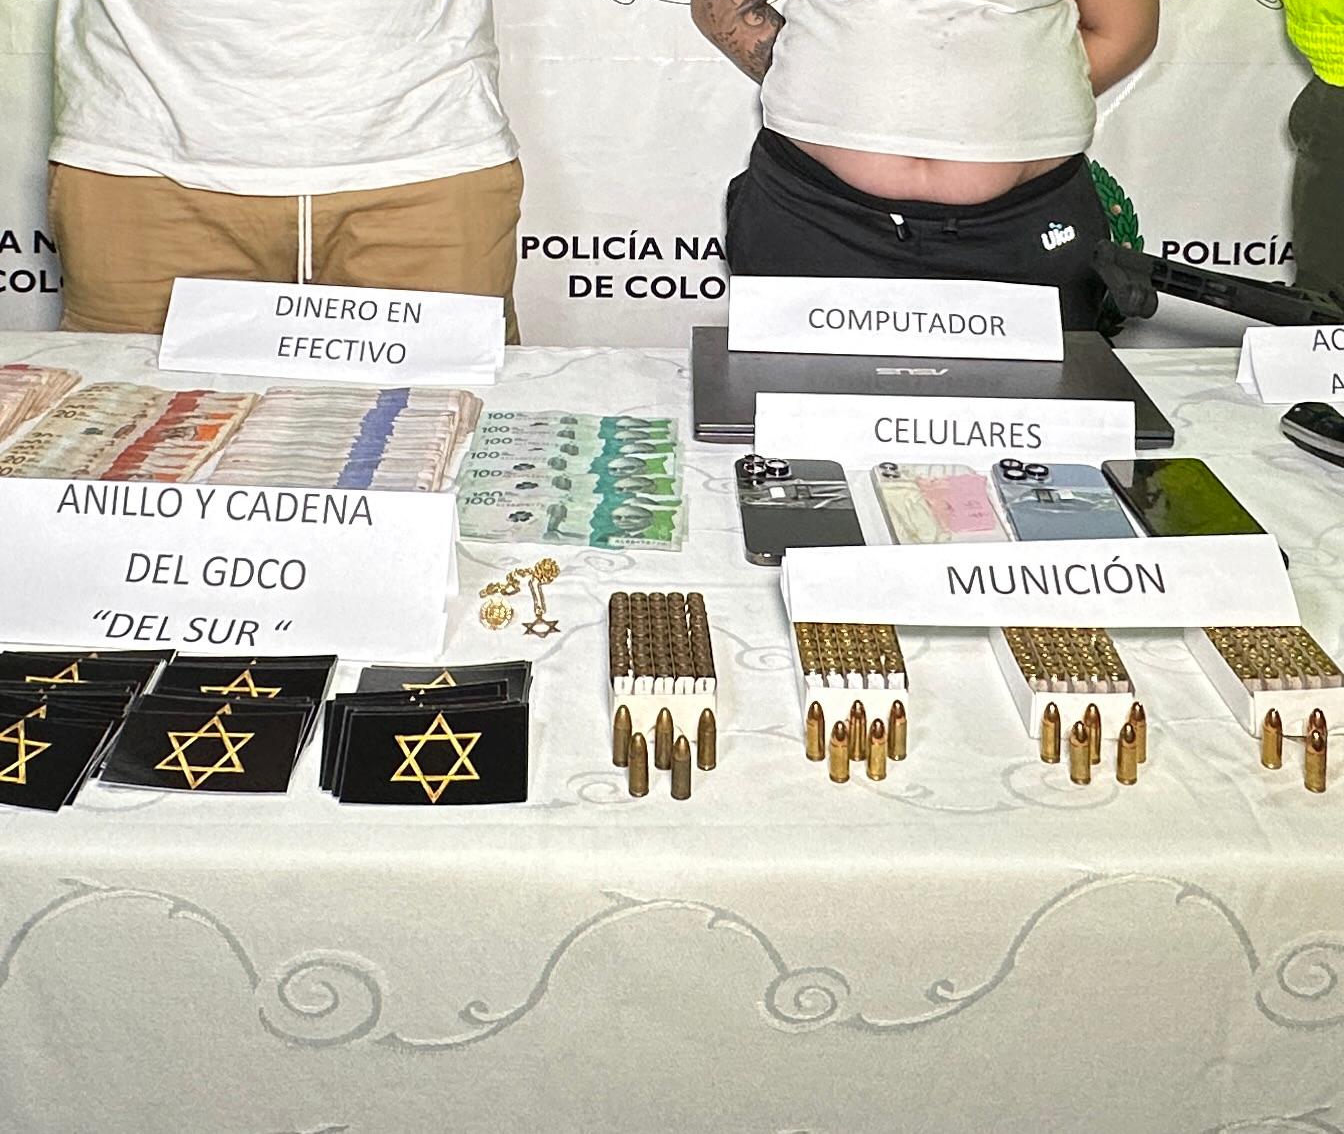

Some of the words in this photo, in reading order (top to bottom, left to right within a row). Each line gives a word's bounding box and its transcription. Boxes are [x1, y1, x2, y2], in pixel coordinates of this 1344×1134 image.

[522, 230, 663, 259] POLICÍA
[570, 276, 613, 297] DE
[276, 296, 377, 320] DINERO
[388, 302, 421, 323] EN
[809, 308, 1005, 336] COMPUTADOR
[278, 337, 406, 364] EFECTIVO
[875, 418, 1041, 449] CELULARES
[57, 484, 182, 517] ANILLO
[196, 489, 215, 519] Y
[227, 491, 372, 525] CADENA
[126, 553, 188, 585] DEL
[203, 556, 305, 590] GDCO
[948, 556, 1165, 595] MUNICIÓN
[183, 618, 259, 646] SUR
